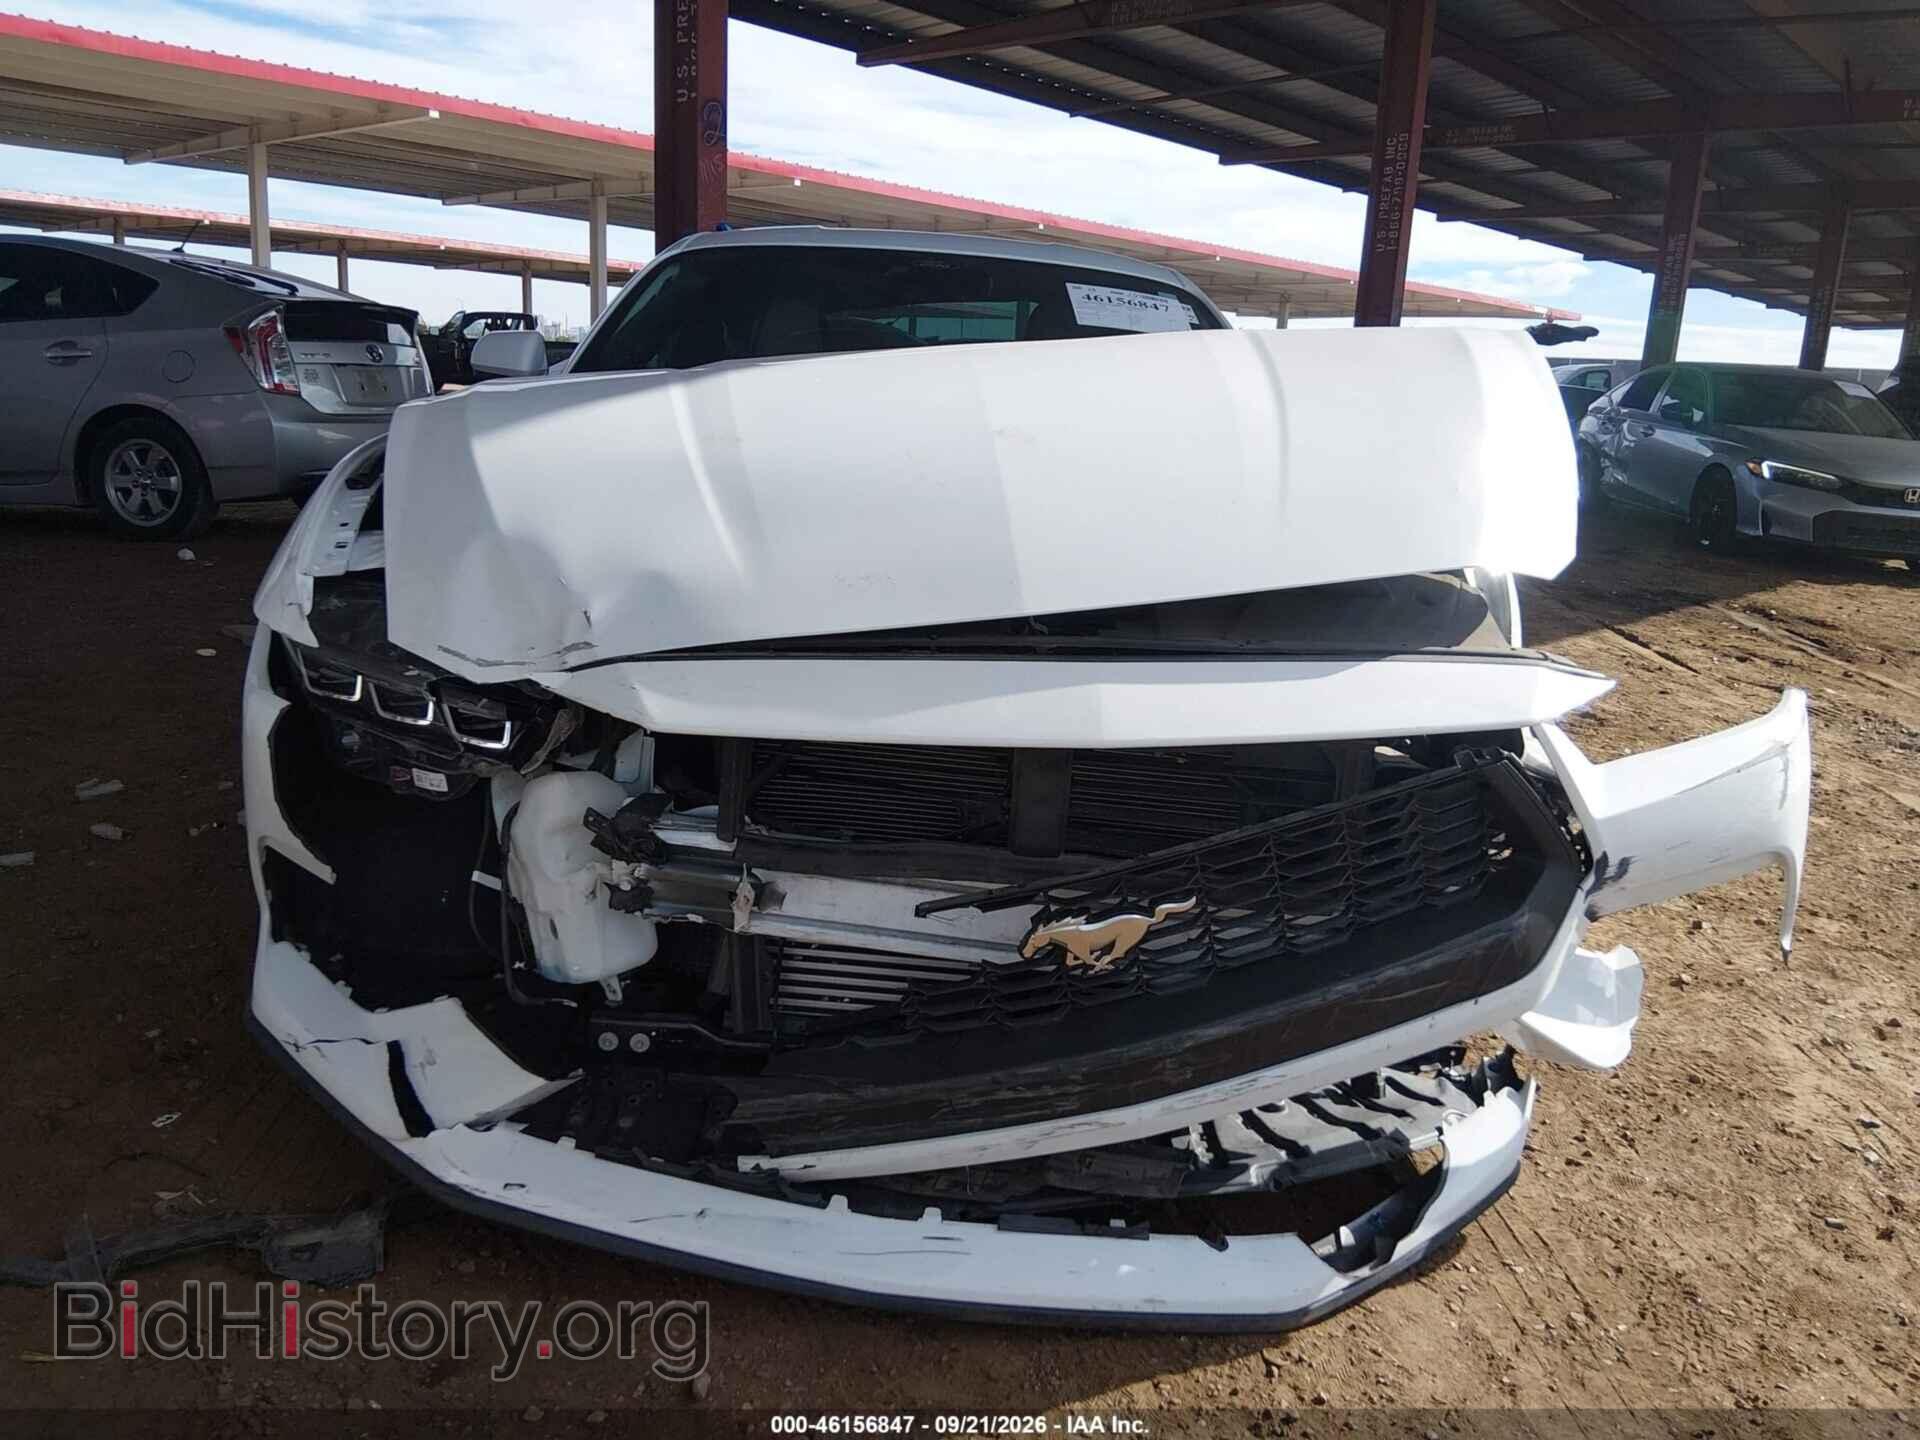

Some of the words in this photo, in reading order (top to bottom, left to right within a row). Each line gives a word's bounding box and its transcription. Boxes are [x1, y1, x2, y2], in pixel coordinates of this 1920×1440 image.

[676, 57, 690, 103] U.S.
[1385, 132, 1398, 159] INC.
[1378, 167, 1394, 219] PREFAB
[1082, 293, 1169, 312] 46156847
